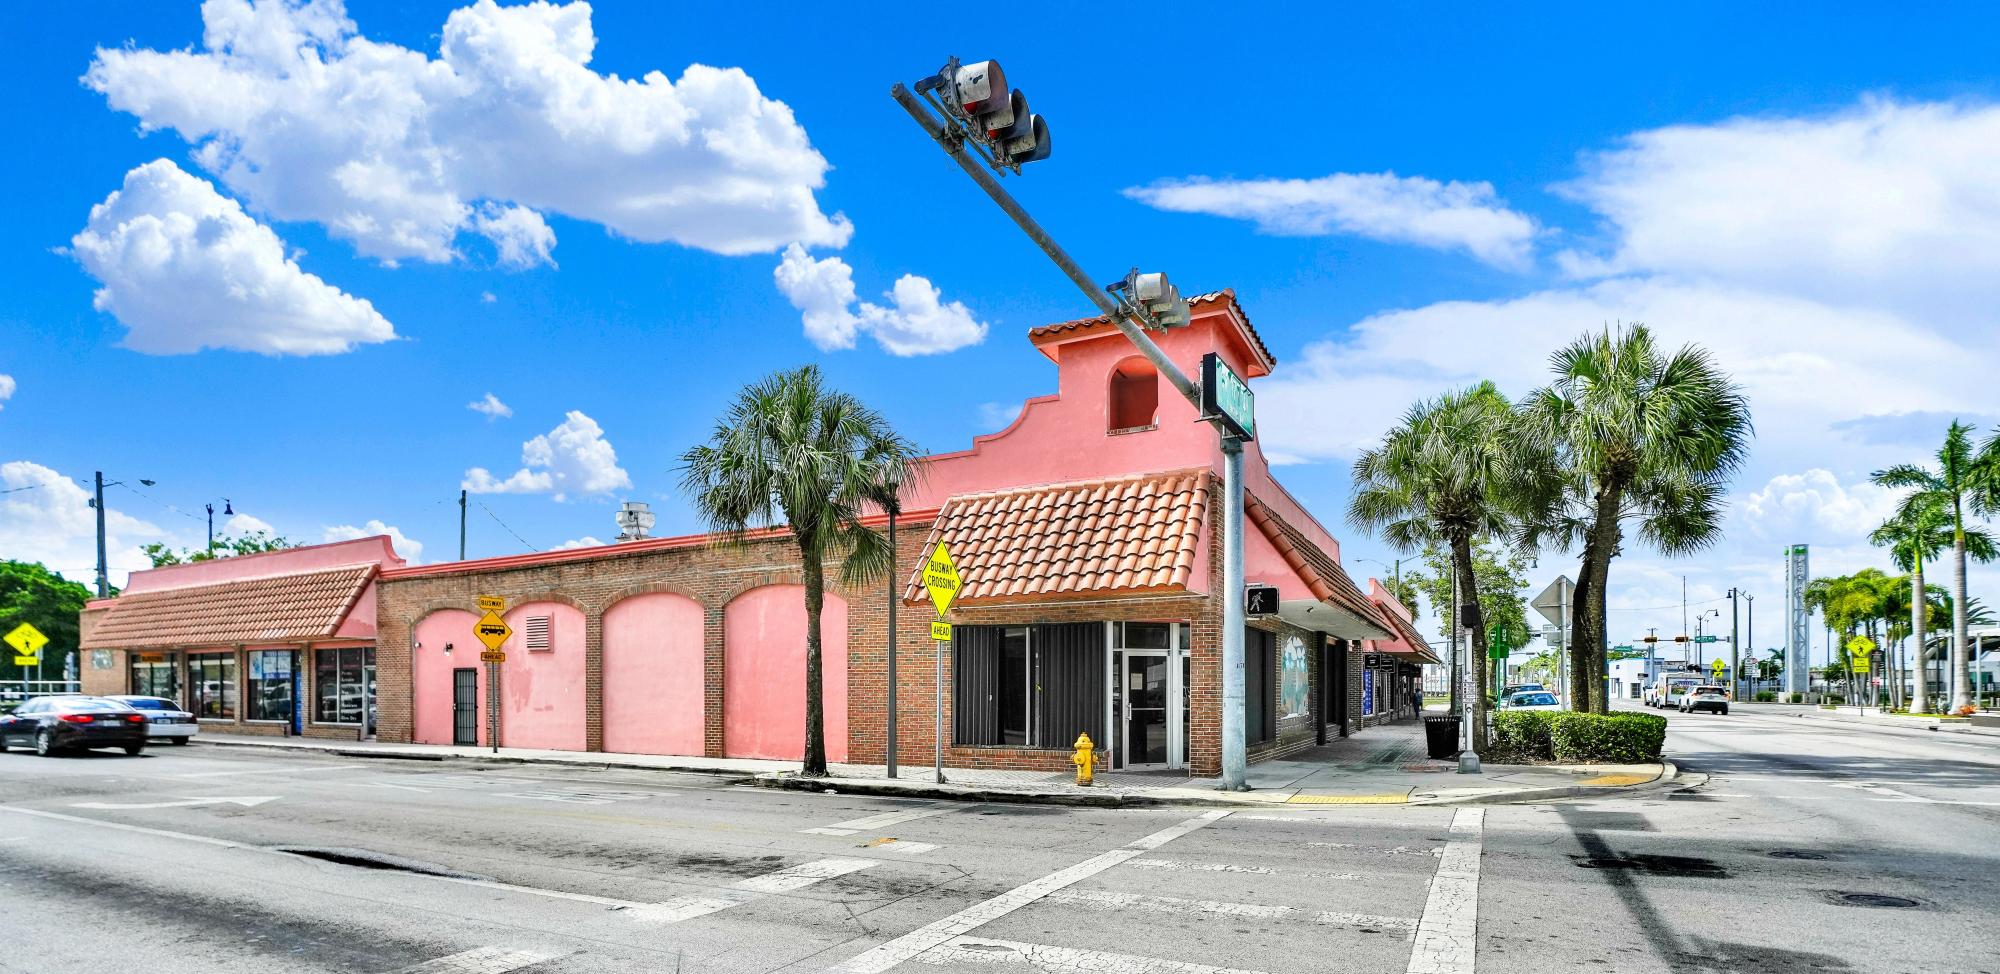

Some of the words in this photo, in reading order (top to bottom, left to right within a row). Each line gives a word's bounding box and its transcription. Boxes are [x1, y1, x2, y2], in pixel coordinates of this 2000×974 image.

[930, 560, 953, 575] BUSWAY
[928, 575, 955, 590] CROSSING
[933, 626, 949, 636] AHEAD
